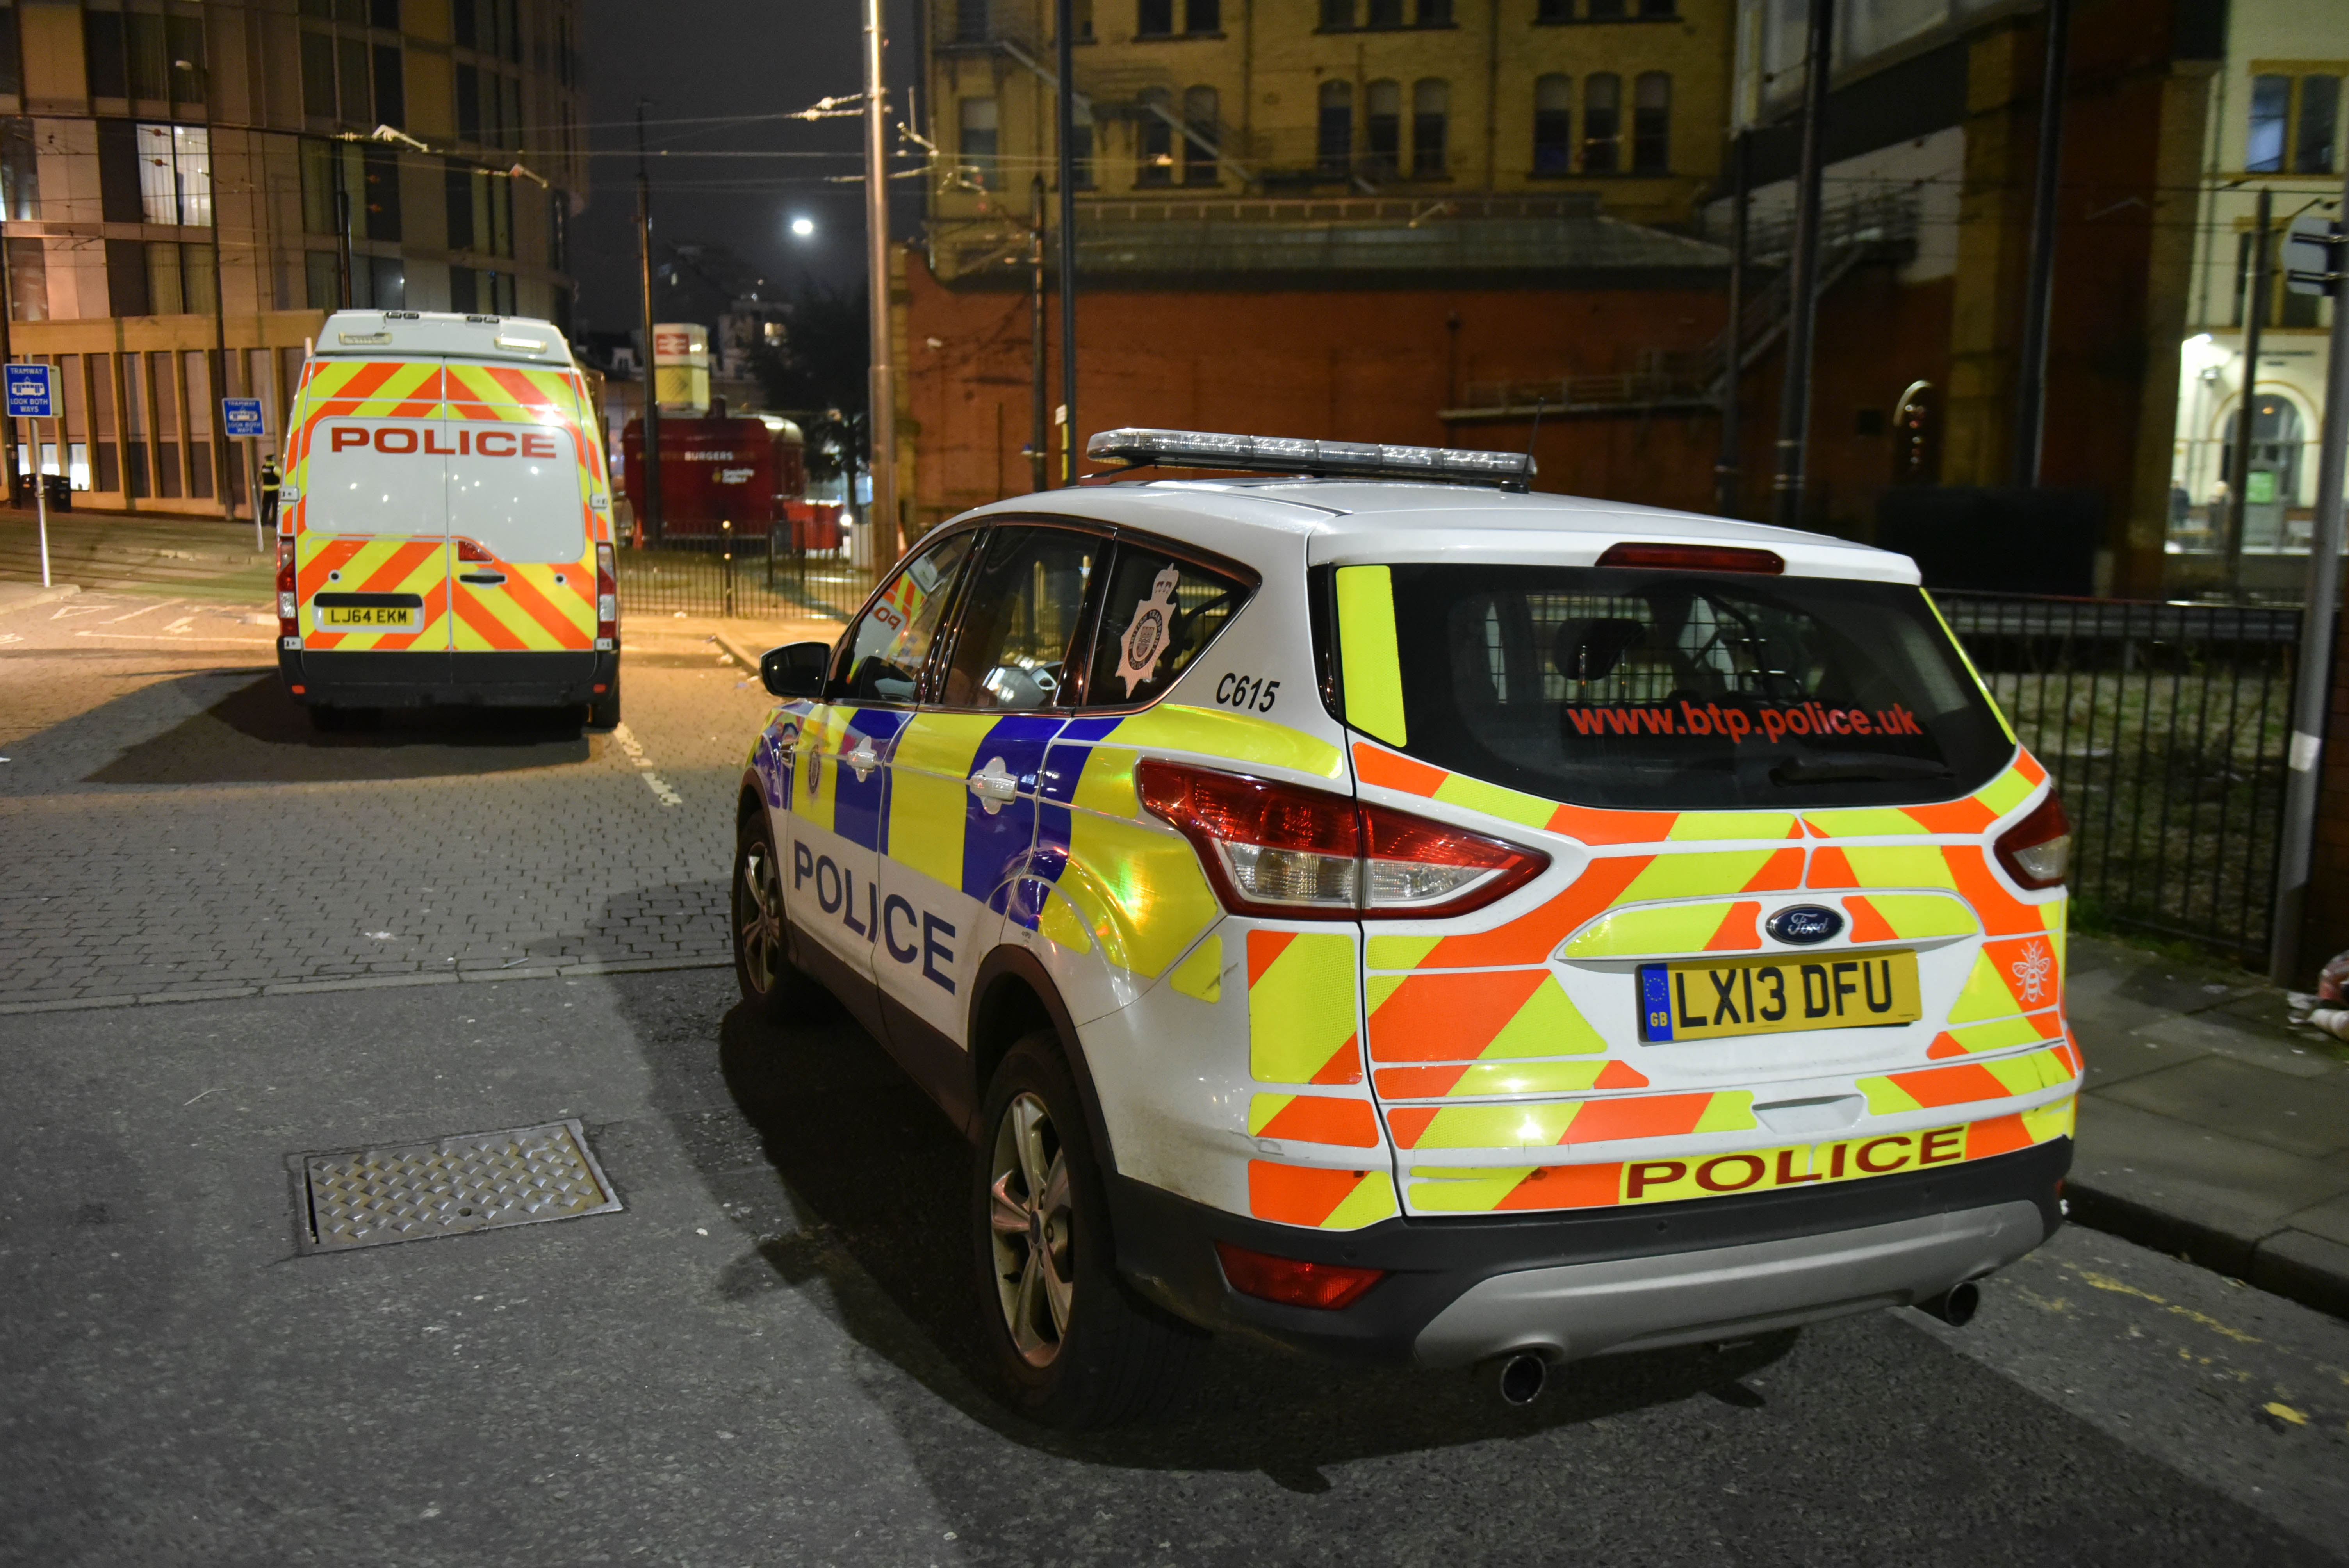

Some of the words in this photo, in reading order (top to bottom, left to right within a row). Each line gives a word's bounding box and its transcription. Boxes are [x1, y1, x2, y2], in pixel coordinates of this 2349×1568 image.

[331, 427, 556, 459] POLICE
[684, 451, 733, 461] BURGERS
[331, 609, 371, 623] LJ64
[377, 609, 407, 623] EKM
[1129, 614, 1147, 649] BRITISH
[1149, 611, 1162, 651] TRANSPORT
[1130, 657, 1146, 669] POLICE
[1216, 673, 1280, 713] C615
[1567, 701, 1923, 743] www.btp.police.uk
[794, 839, 955, 996] POLICE
[1787, 912, 1829, 935] Ford
[1675, 966, 1787, 1028] LX13
[1800, 959, 1892, 1018] DFU
[1650, 1012, 1668, 1027] GB
[1626, 1126, 1964, 1199] POLICE
